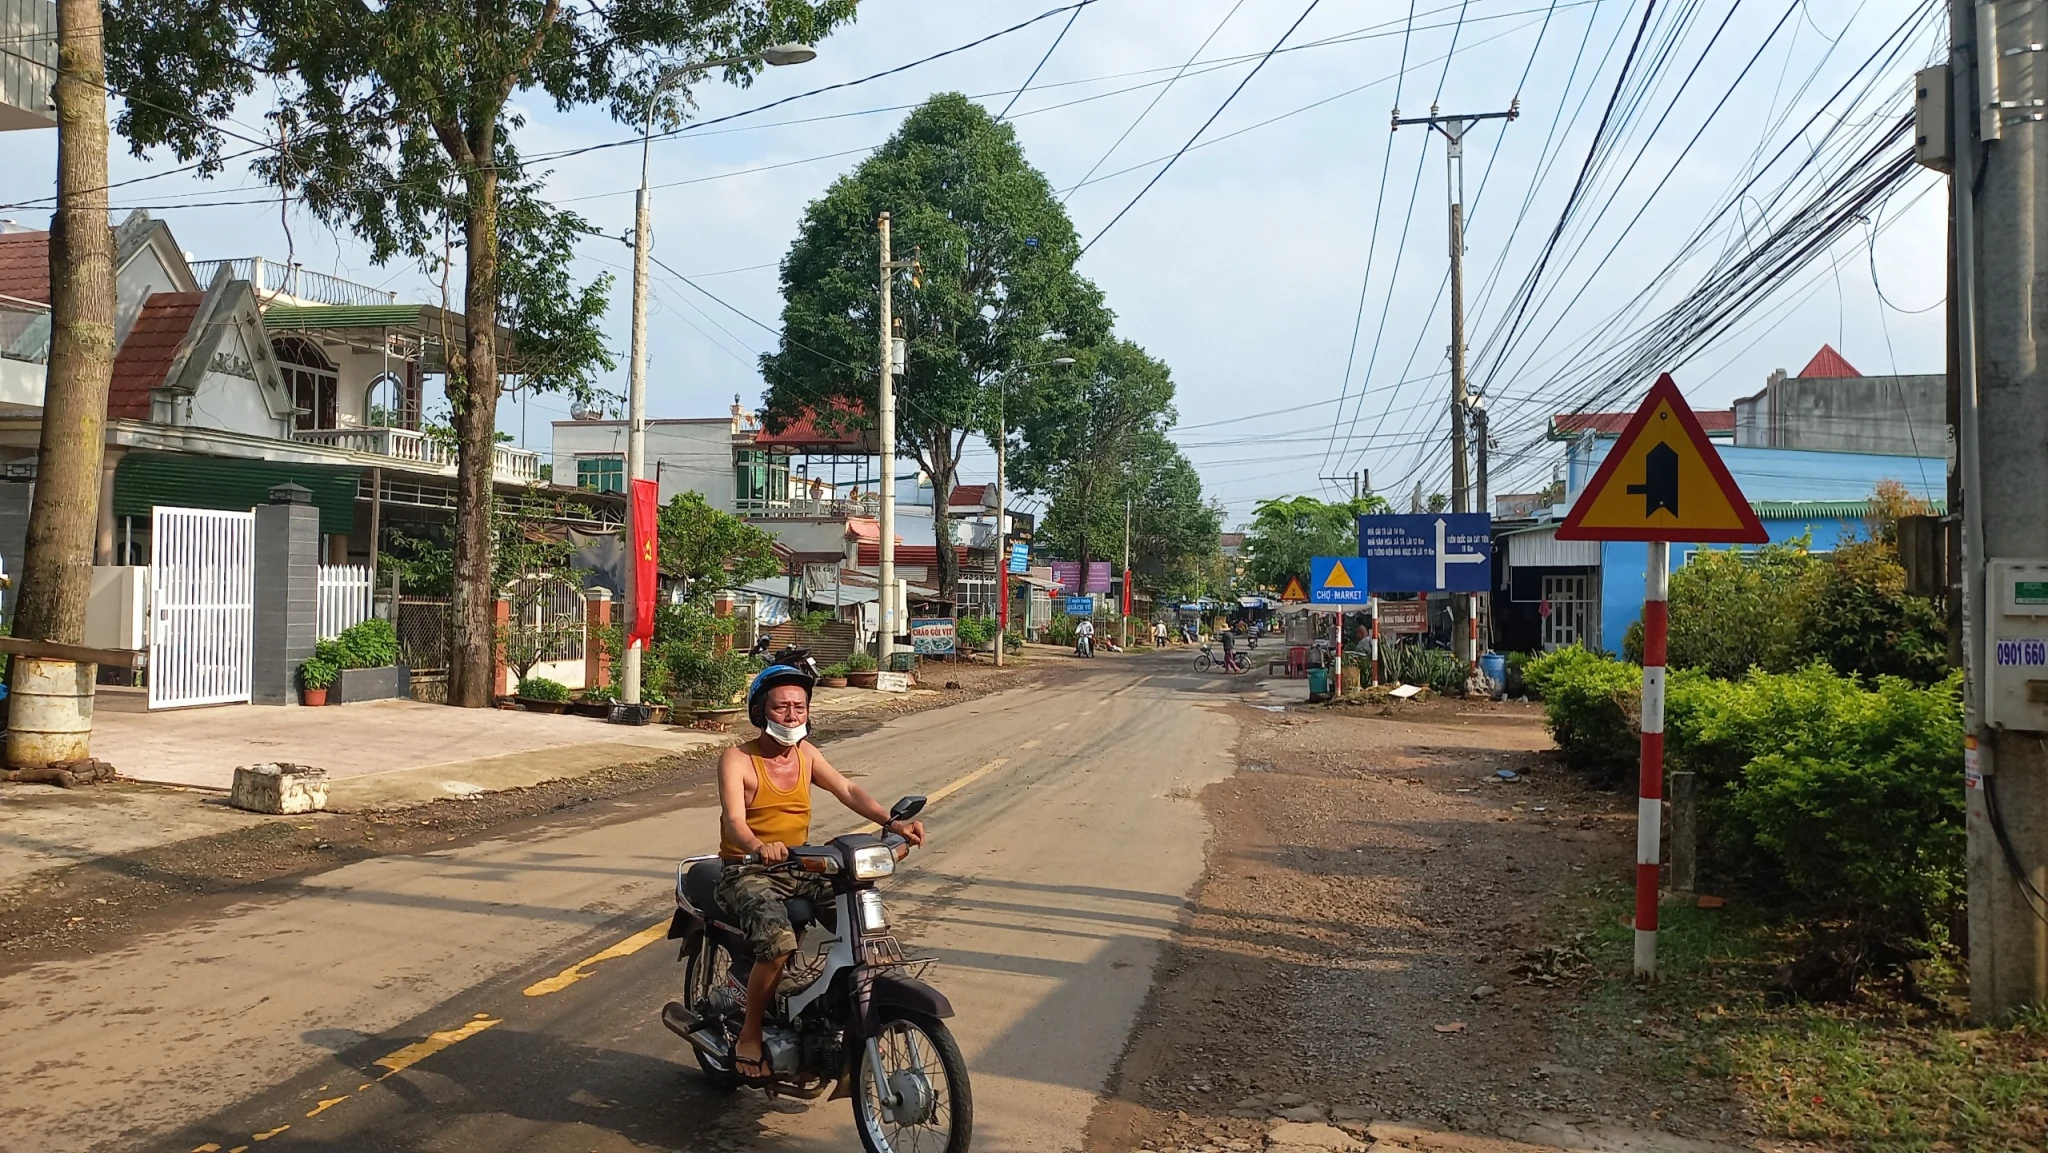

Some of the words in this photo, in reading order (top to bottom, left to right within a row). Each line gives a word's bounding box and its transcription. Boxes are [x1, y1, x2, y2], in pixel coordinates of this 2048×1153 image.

[1317, 589, 1330, 601] CHỢ
[1334, 591, 1362, 600] MARKET
[930, 626, 941, 636] GỎI
[941, 628, 952, 637] VỊT
[1997, 643, 2021, 665] 0901
[2025, 643, 2045, 665] 660
